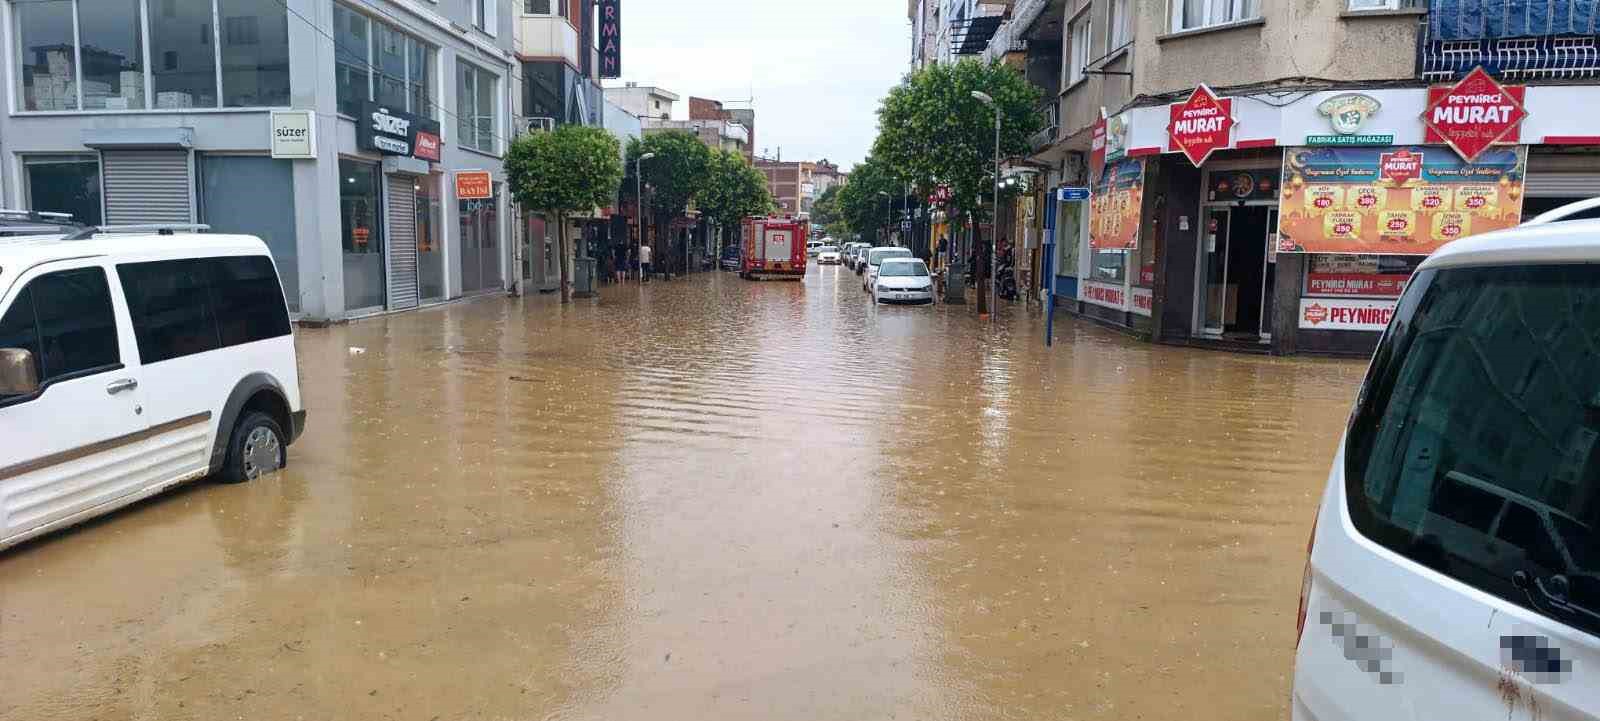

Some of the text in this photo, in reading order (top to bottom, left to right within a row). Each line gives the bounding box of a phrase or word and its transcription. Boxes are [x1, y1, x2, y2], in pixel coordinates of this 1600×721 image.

[602, 0, 617, 73] RMAN
[1448, 93, 1502, 104] PEYNİRCİ
[1433, 105, 1514, 124] MURAT
[1174, 116, 1226, 135] MURAT
[1384, 162, 1417, 171] MURAT
